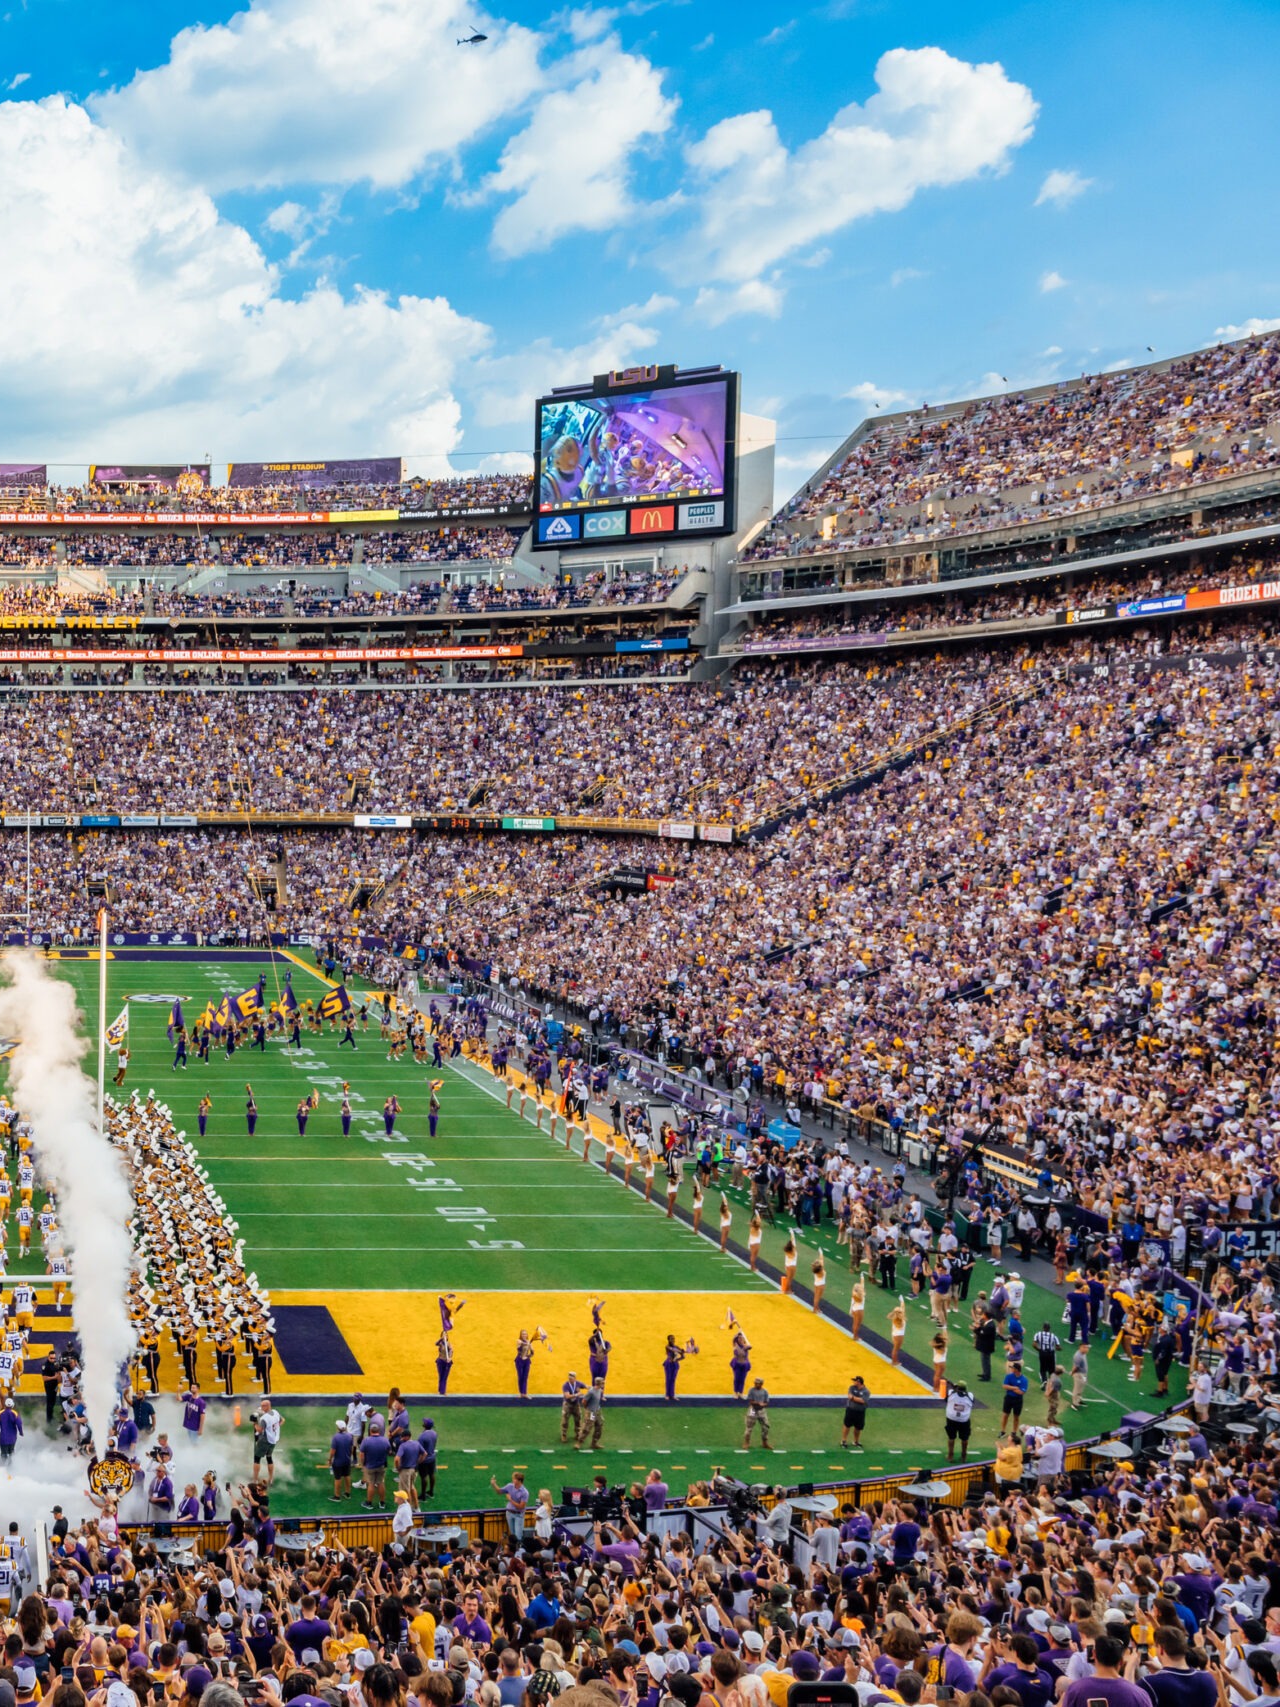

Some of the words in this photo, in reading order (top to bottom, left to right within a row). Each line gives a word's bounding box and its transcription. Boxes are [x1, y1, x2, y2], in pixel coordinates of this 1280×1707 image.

[608, 364, 658, 388] LSU
[689, 505, 714, 515] PEOPLES
[586, 516, 624, 532] COX
[1219, 584, 1260, 604] ORDER
[64, 616, 141, 628] VALLEY
[336, 650, 363, 658] ORDER
[451, 818, 469, 827] 3:43
[235, 988, 259, 1017] E
[321, 991, 343, 1018] S
[381, 1152, 436, 1166] 20
[22, 1172, 32, 1181] 35
[406, 1177, 464, 1191] 15
[20, 1212, 29, 1221] 13
[435, 1207, 497, 1222] 10
[467, 1240, 526, 1248] 5
[53, 1263, 66, 1273] 84
[17, 1292, 29, 1303] 77
[96, 1579, 110, 1595] 33
